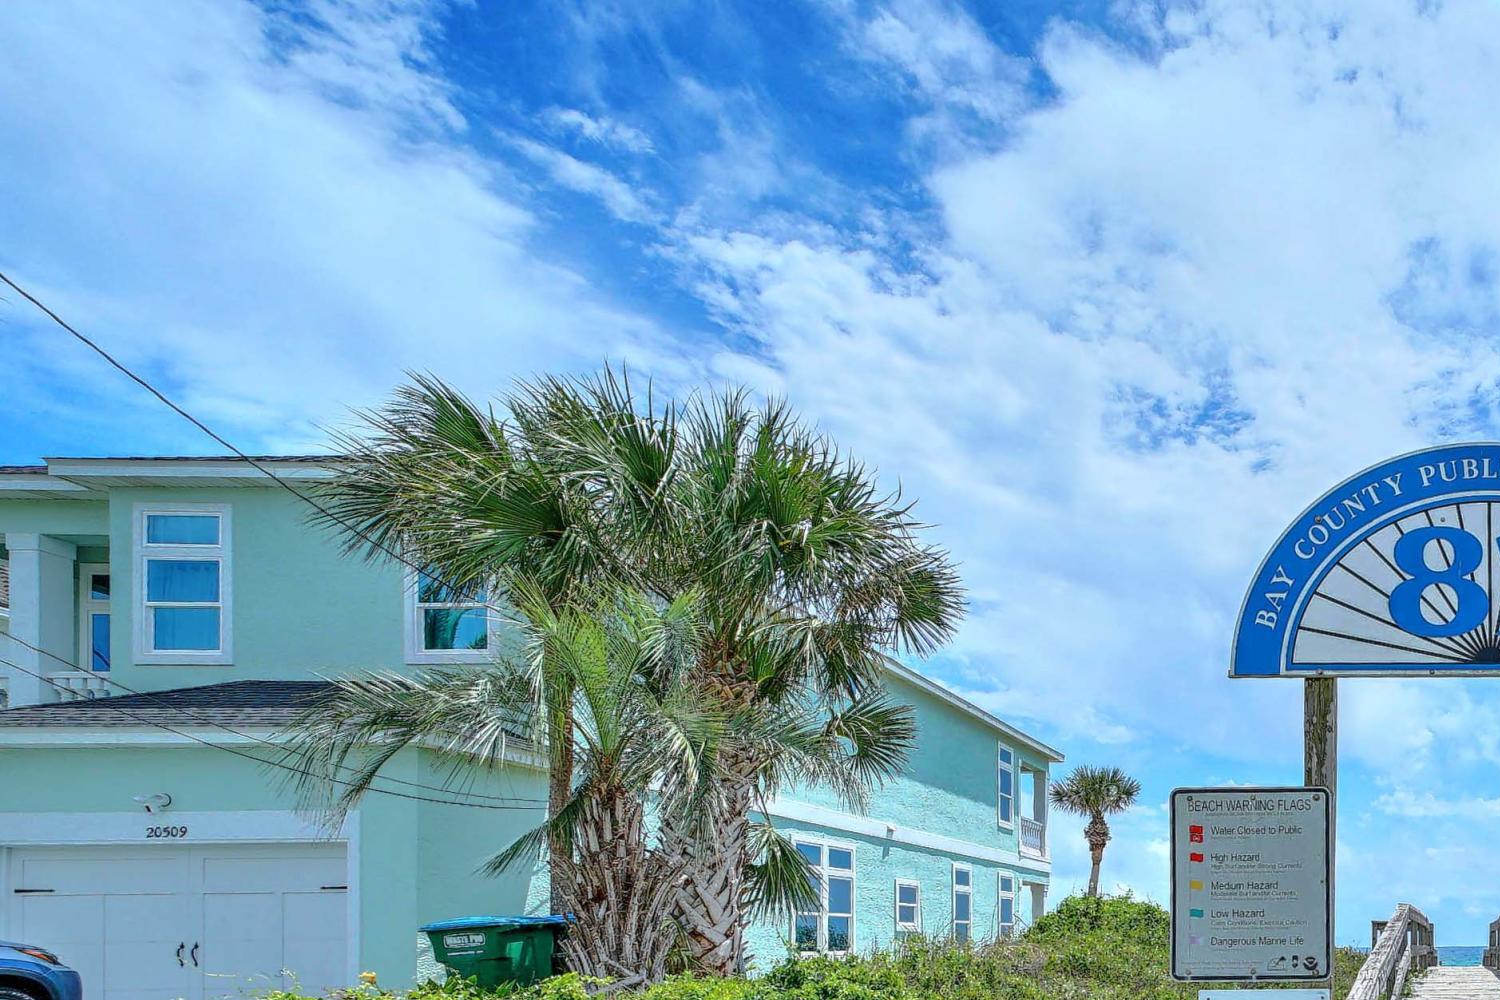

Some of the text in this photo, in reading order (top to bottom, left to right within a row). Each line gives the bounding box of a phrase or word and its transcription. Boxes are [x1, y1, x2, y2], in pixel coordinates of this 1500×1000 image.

[1255, 569, 1296, 631] BAY
[1295, 472, 1404, 560] COUNTY
[1188, 799, 1312, 812] BEACH WARNING FLAGS
[146, 826, 188, 838] 20509
[1210, 825, 1302, 835] Water Closed to Public
[1211, 853, 1259, 864] High Hazard
[1211, 881, 1278, 890] Medium Hazard
[1211, 909, 1264, 918] Low Hazard
[1211, 936, 1304, 948] Dangerous Marine Life
